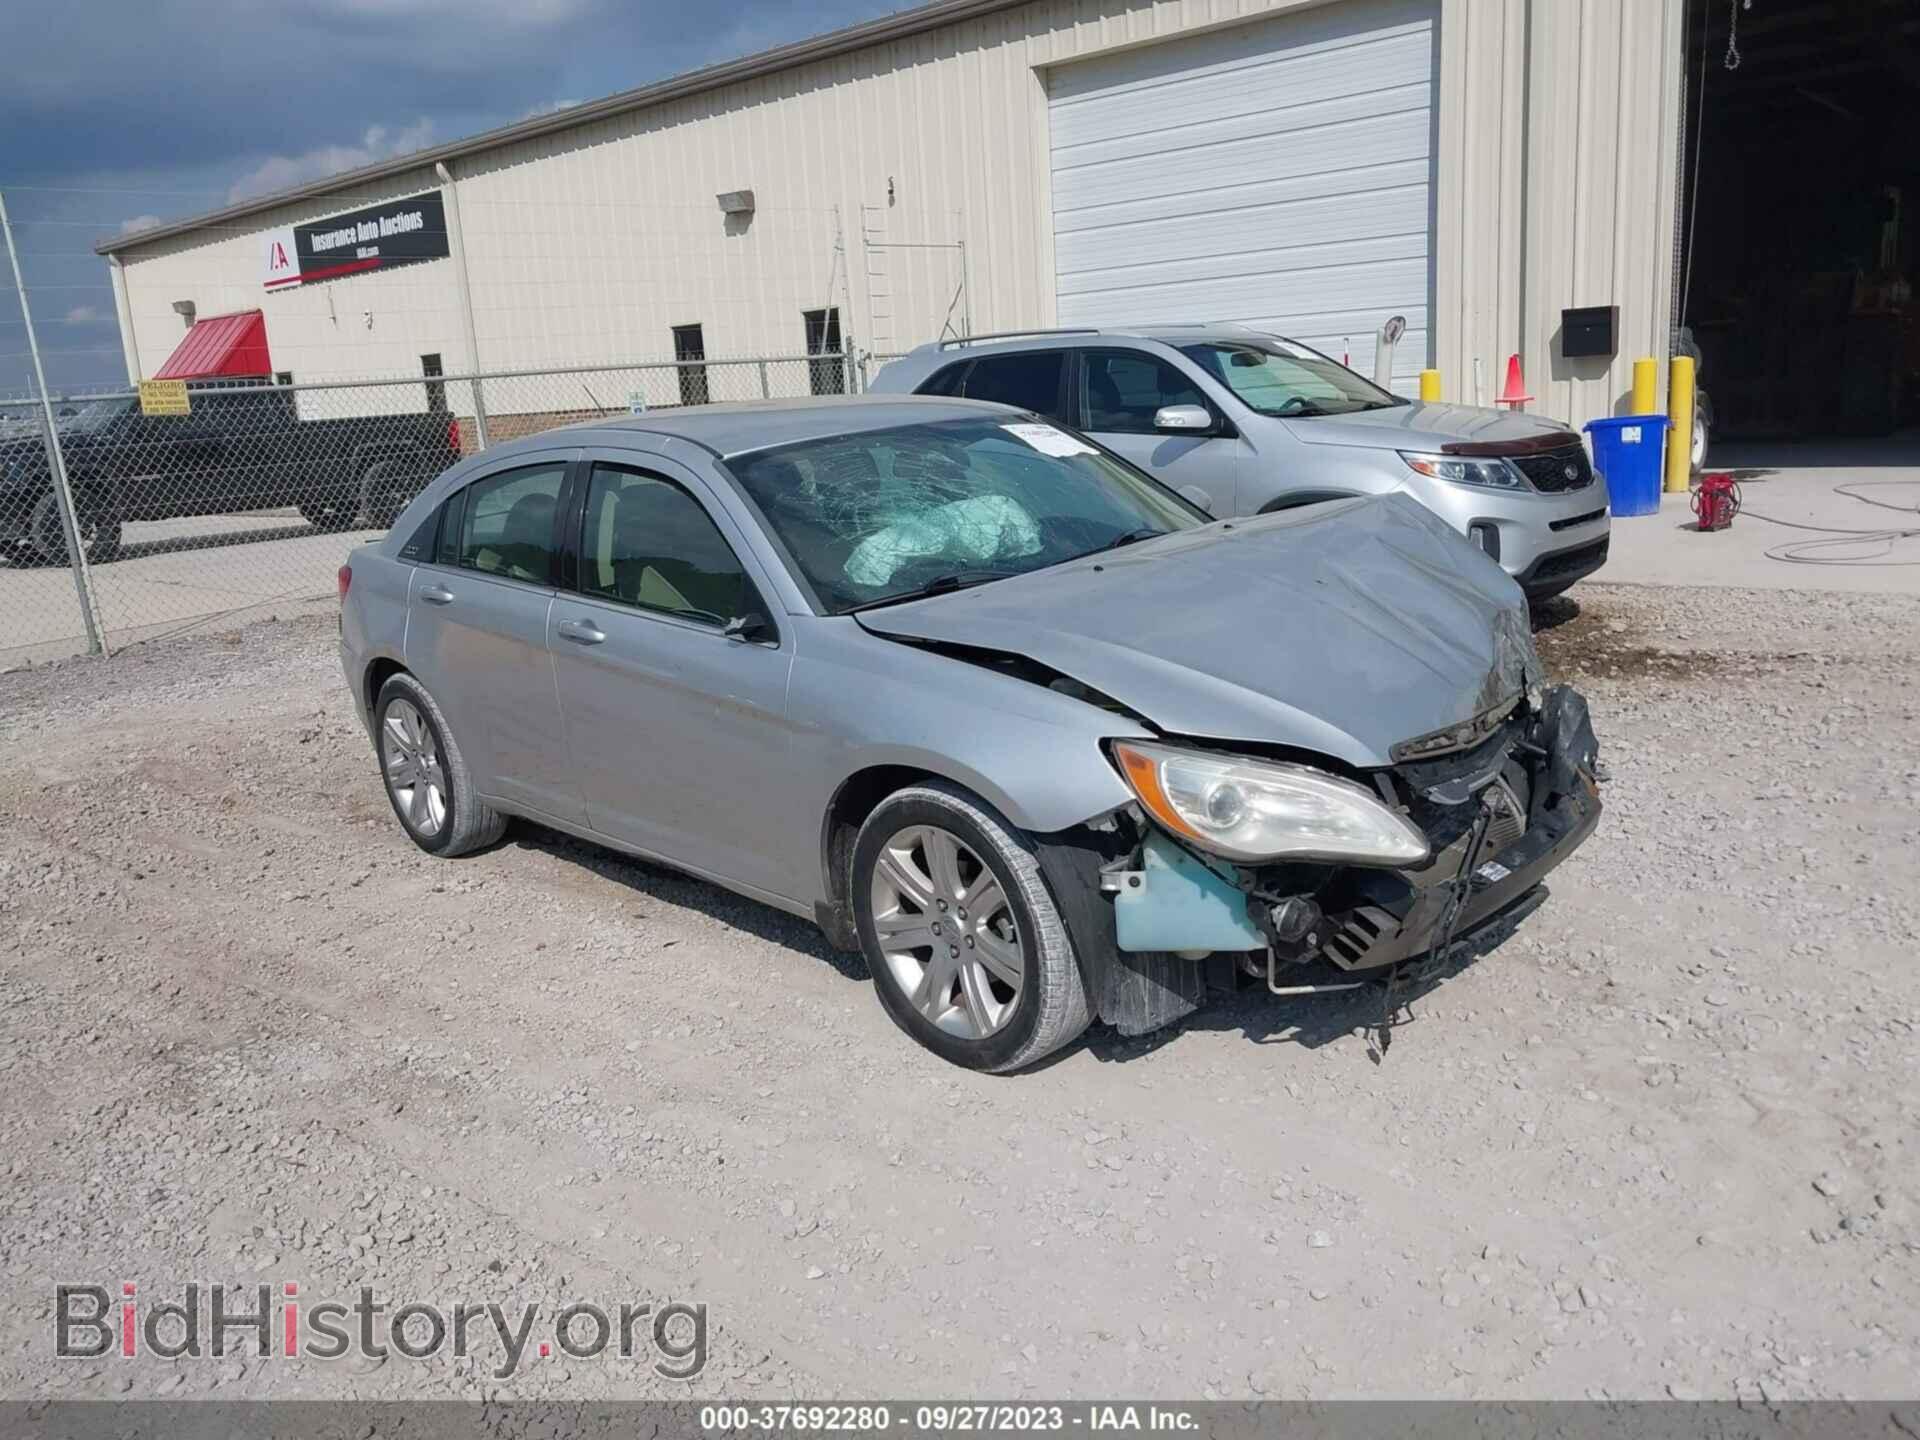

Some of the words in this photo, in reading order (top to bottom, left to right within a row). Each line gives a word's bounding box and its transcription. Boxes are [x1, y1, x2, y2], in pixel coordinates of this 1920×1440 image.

[311, 226, 357, 252] Insurance
[356, 221, 379, 242] Auto
[380, 211, 424, 238] Auctions
